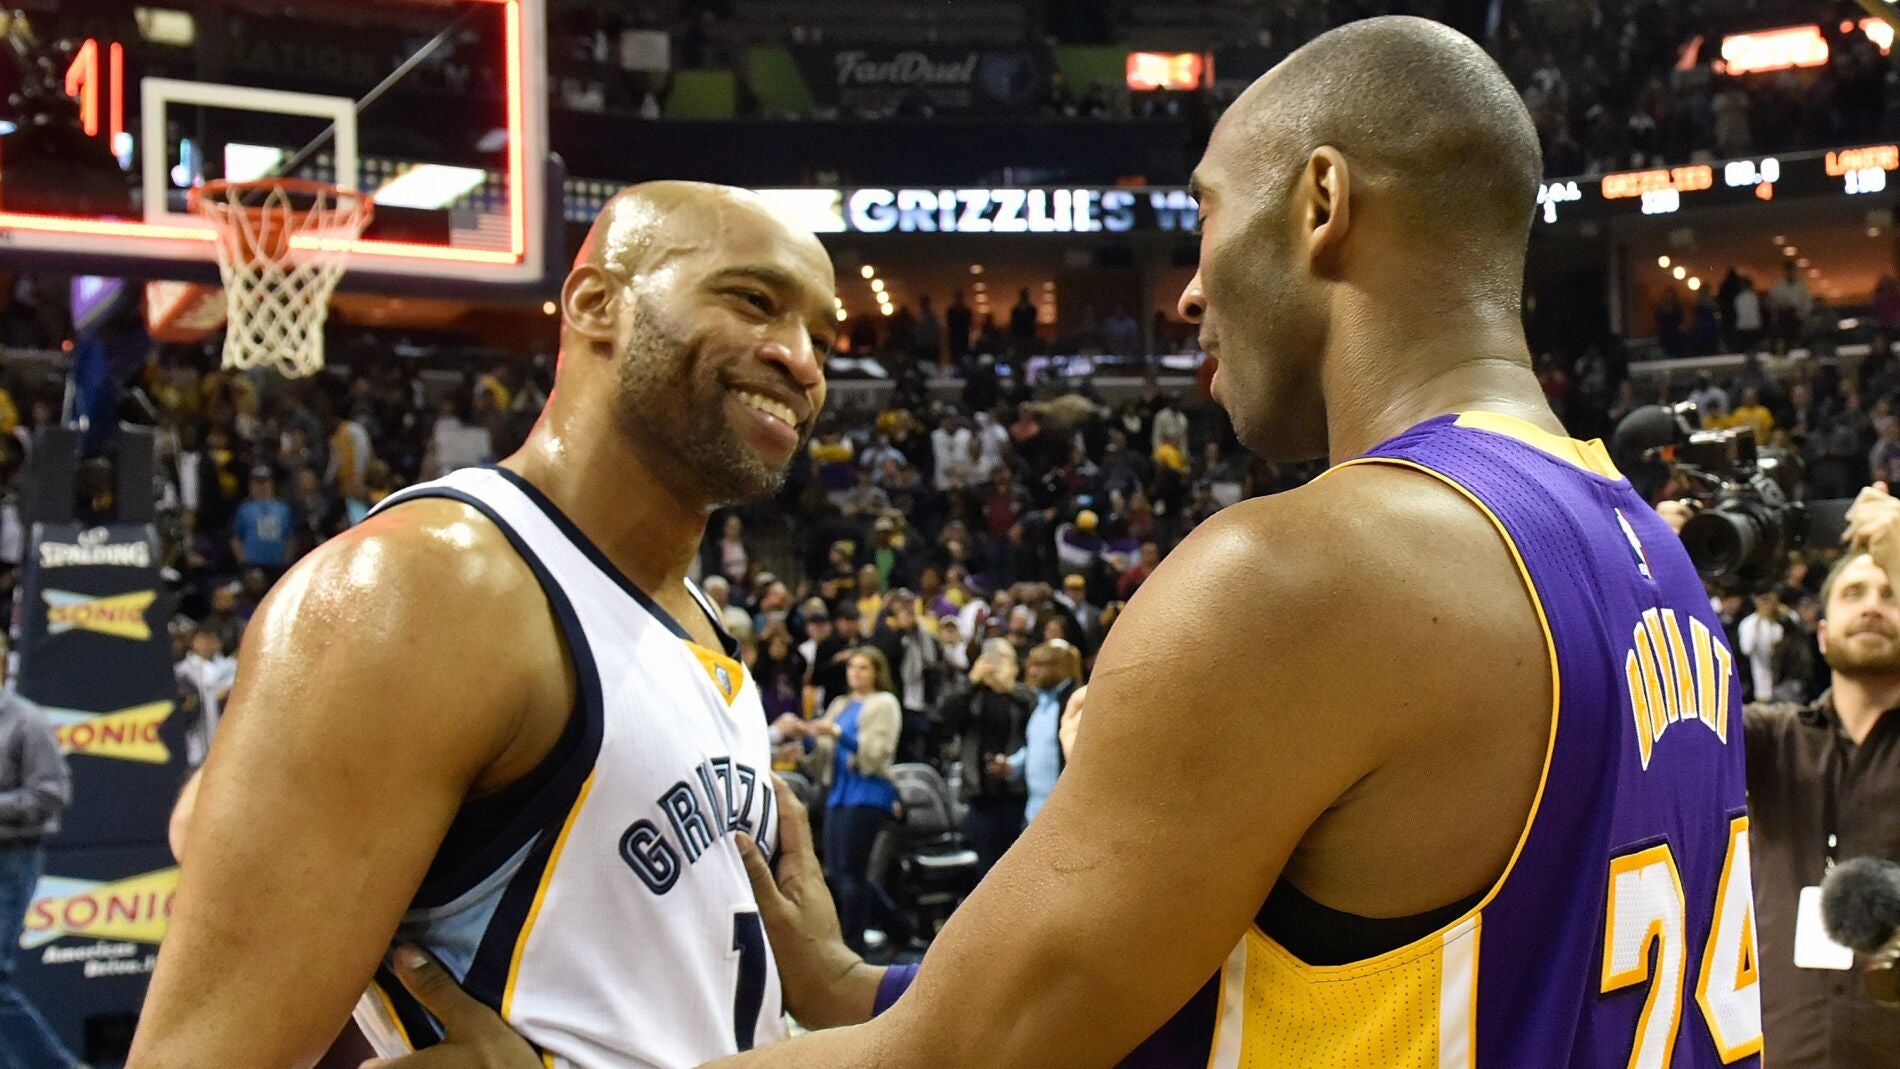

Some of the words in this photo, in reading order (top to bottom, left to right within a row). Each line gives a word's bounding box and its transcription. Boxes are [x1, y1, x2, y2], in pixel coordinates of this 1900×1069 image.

[834, 50, 979, 86] FanDuel
[849, 188, 1135, 232] GRIZZLIES
[39, 541, 149, 568] SPALDING
[52, 604, 144, 628] SONIC
[1600, 815, 1764, 1069] 24
